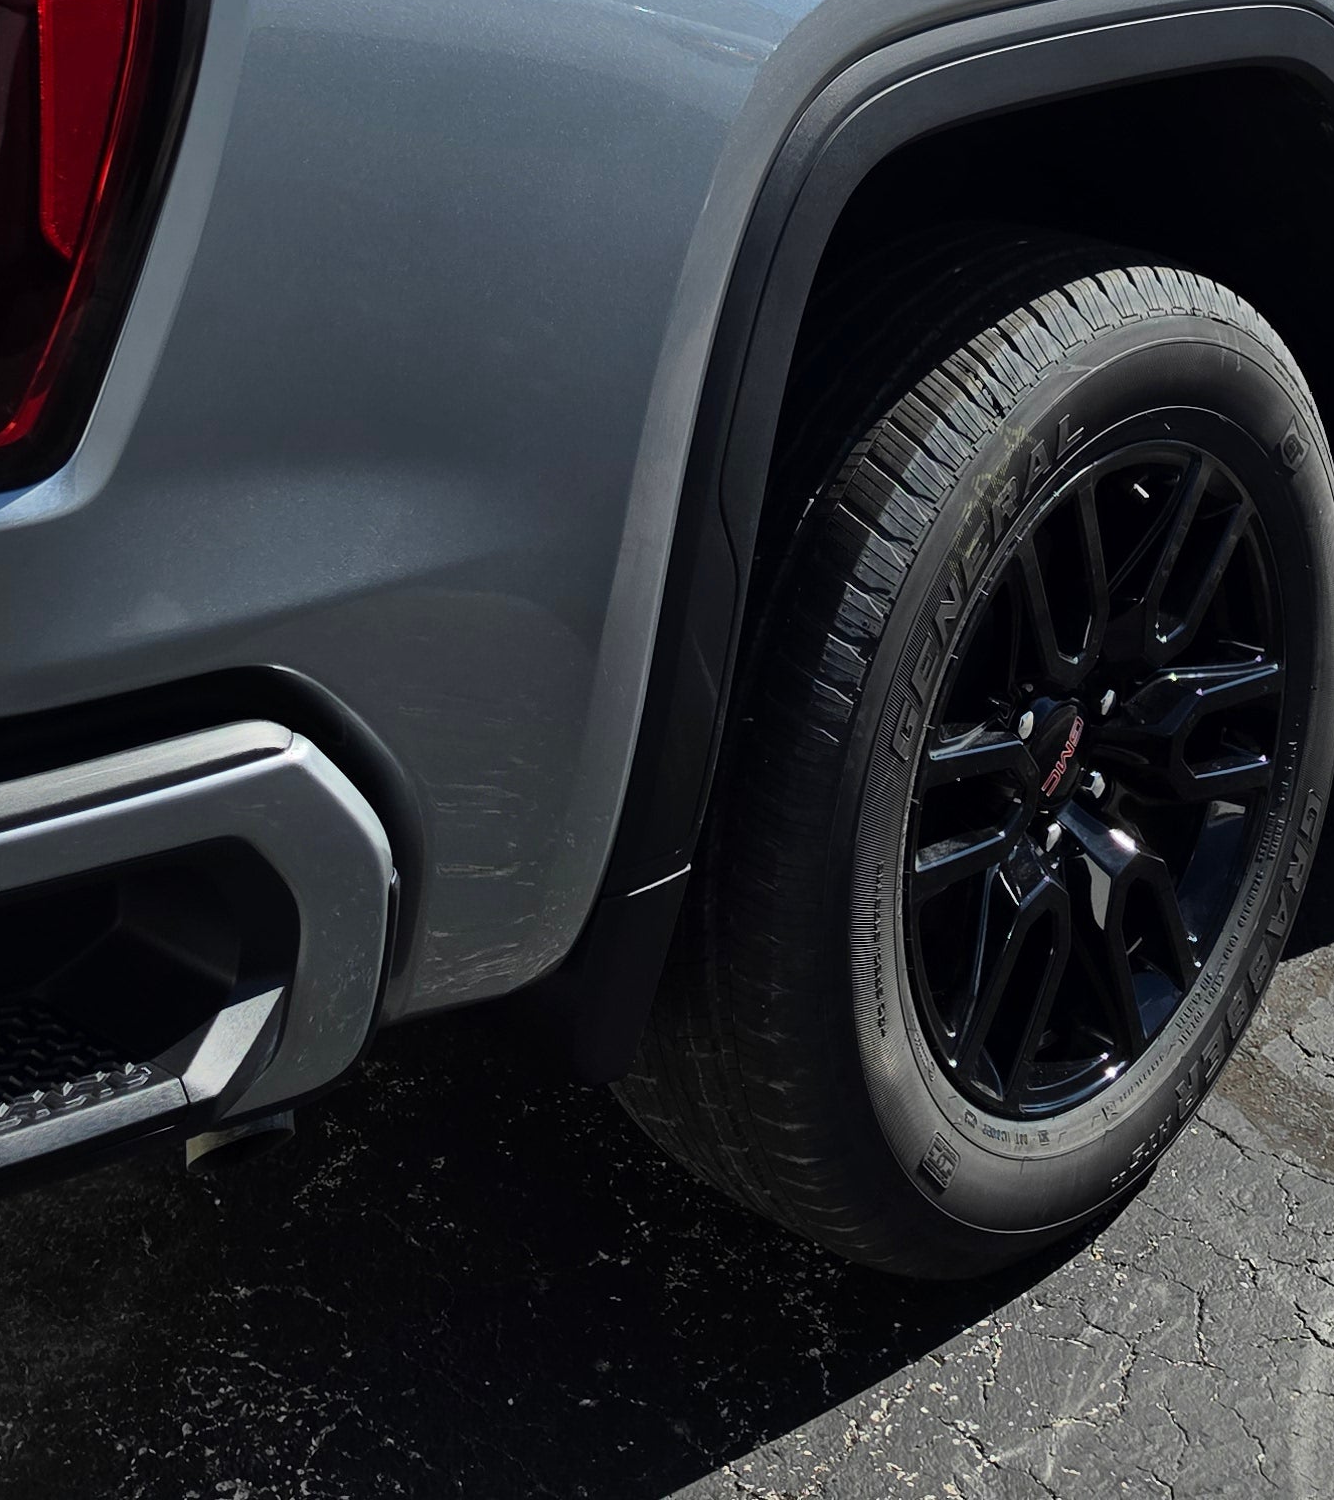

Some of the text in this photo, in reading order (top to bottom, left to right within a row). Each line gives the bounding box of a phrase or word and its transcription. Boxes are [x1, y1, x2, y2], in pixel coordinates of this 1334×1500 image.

[892, 414, 1084, 761] GENERAL
[1041, 715, 1084, 797] GMC
[1174, 787, 1323, 1120] GRABBER
